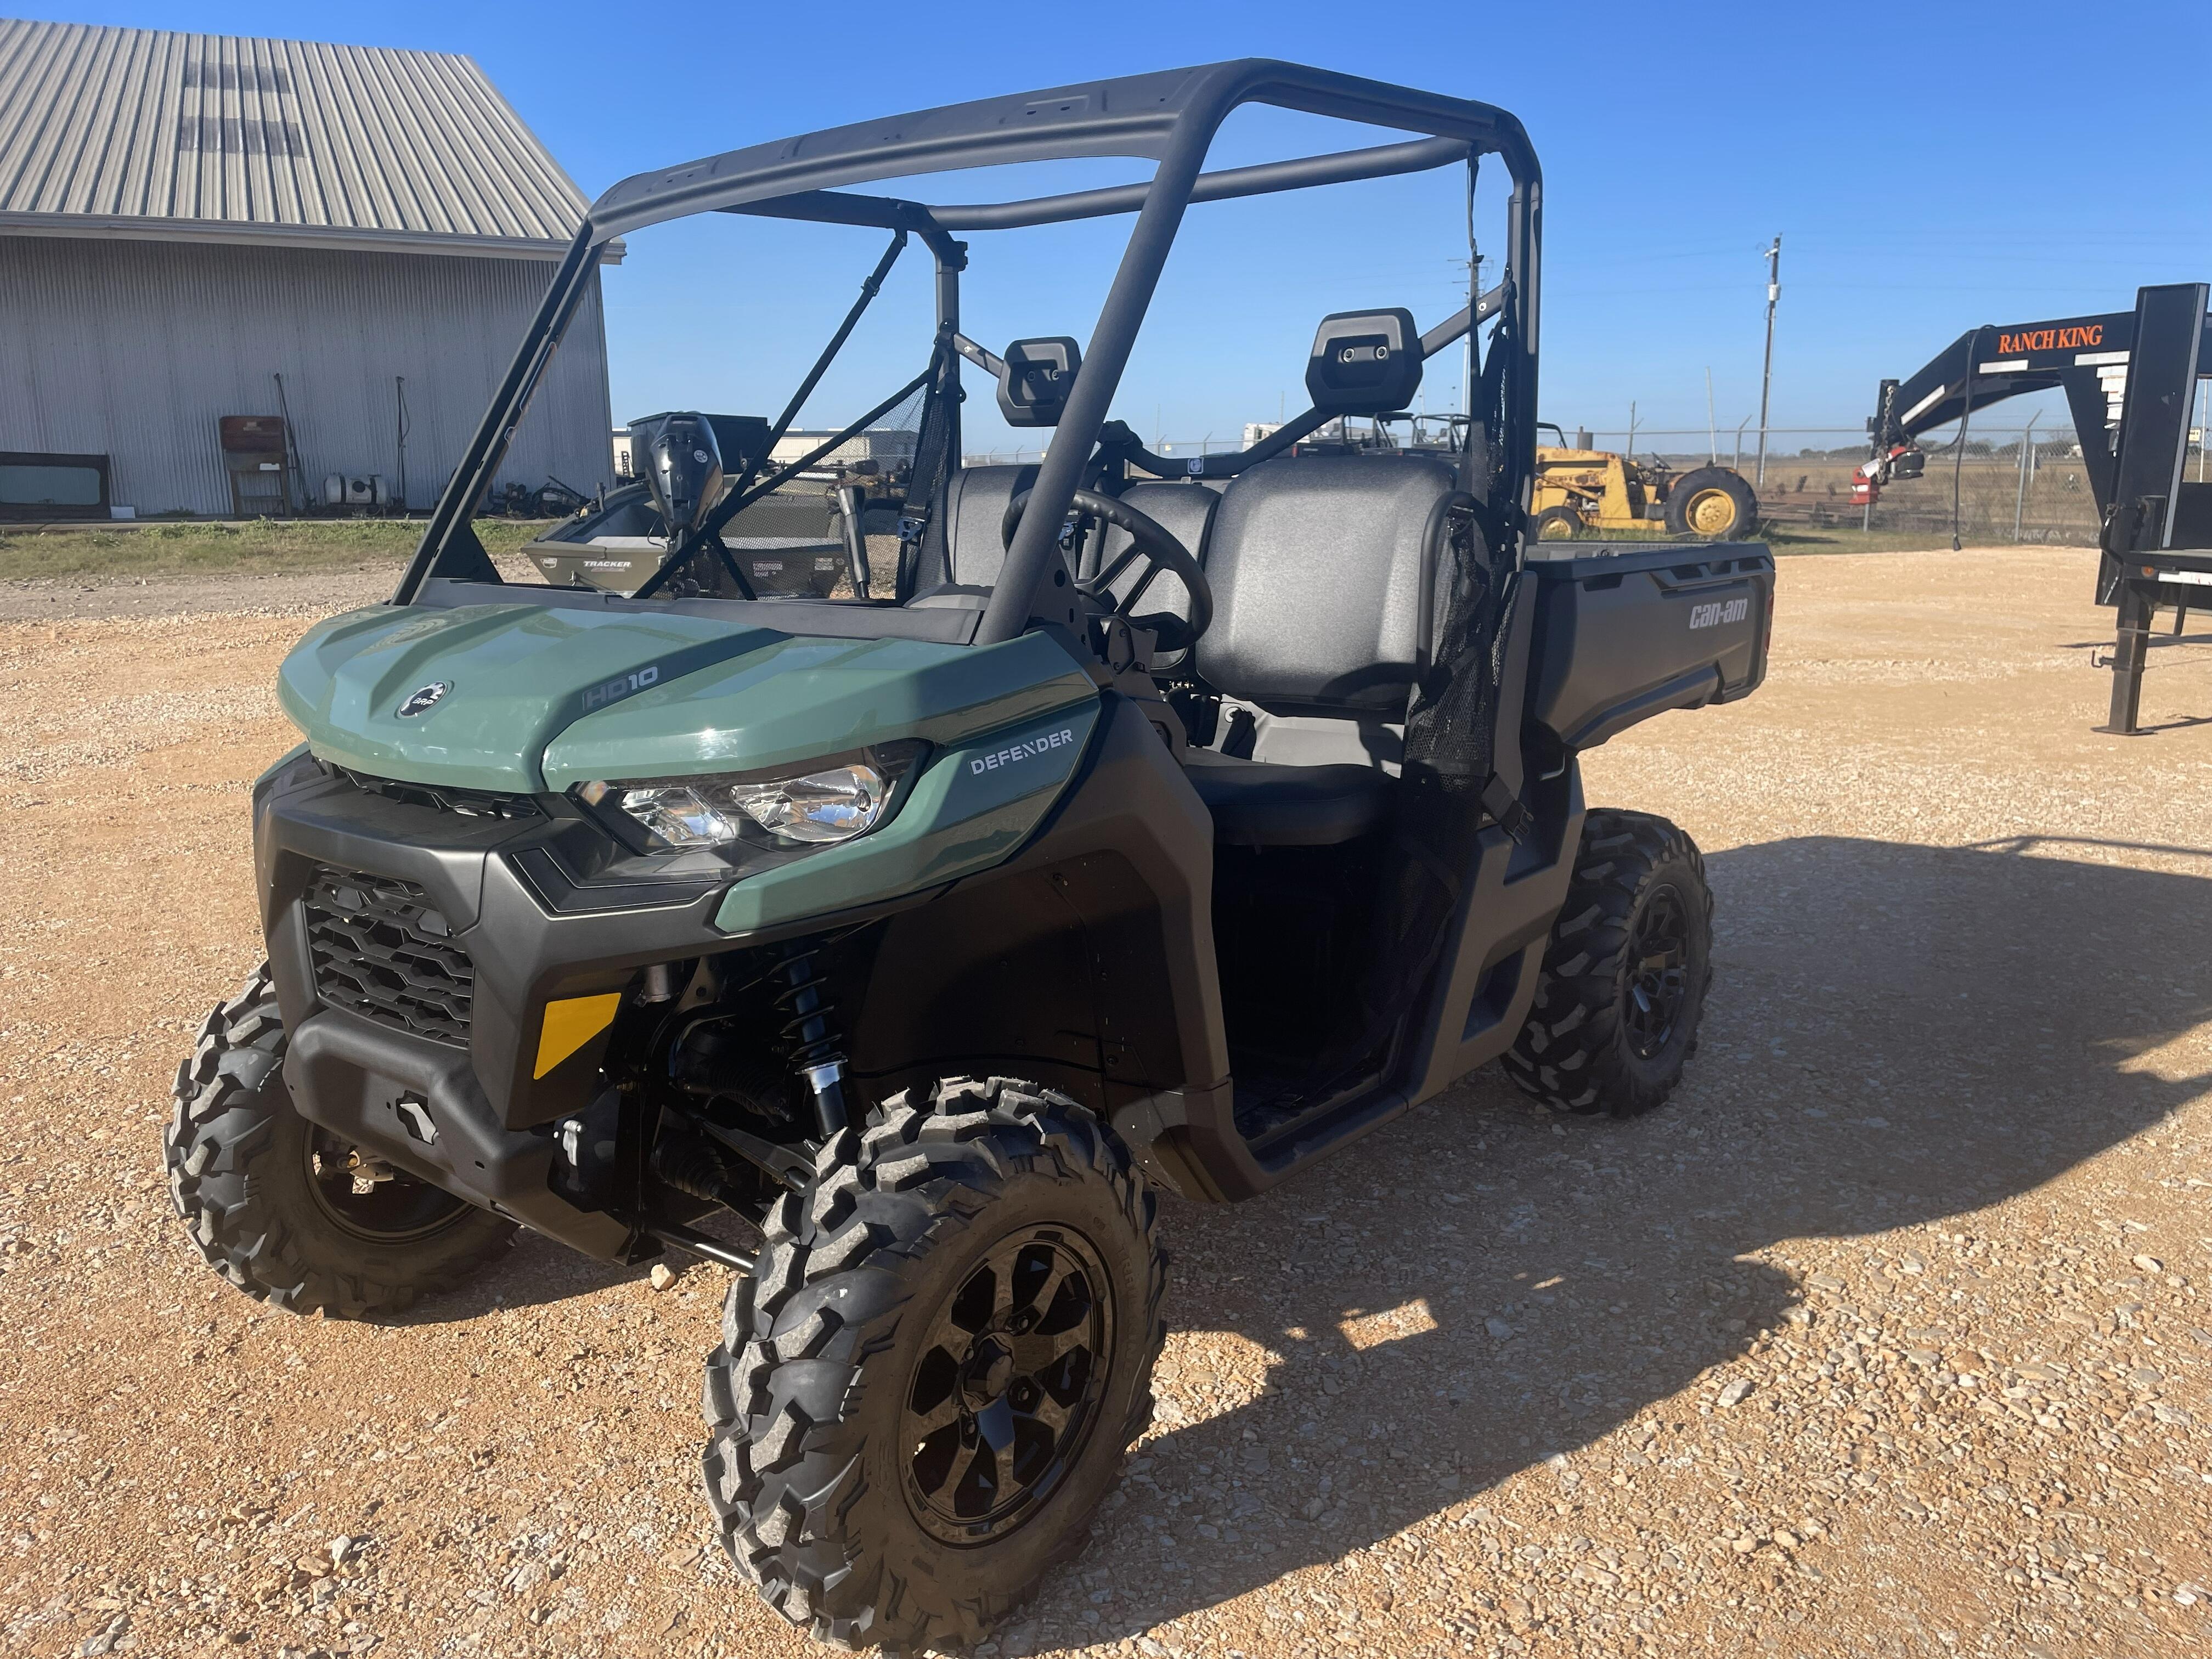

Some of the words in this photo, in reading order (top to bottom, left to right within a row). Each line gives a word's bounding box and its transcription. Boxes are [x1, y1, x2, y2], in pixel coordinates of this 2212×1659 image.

[1998, 329, 2056, 354] RANCH
[2056, 324, 2103, 349] KING
[1689, 597, 1748, 629] can-am
[412, 697, 435, 706] BRP
[586, 666, 658, 709] HD10
[970, 729, 1073, 775] DEFENDER
